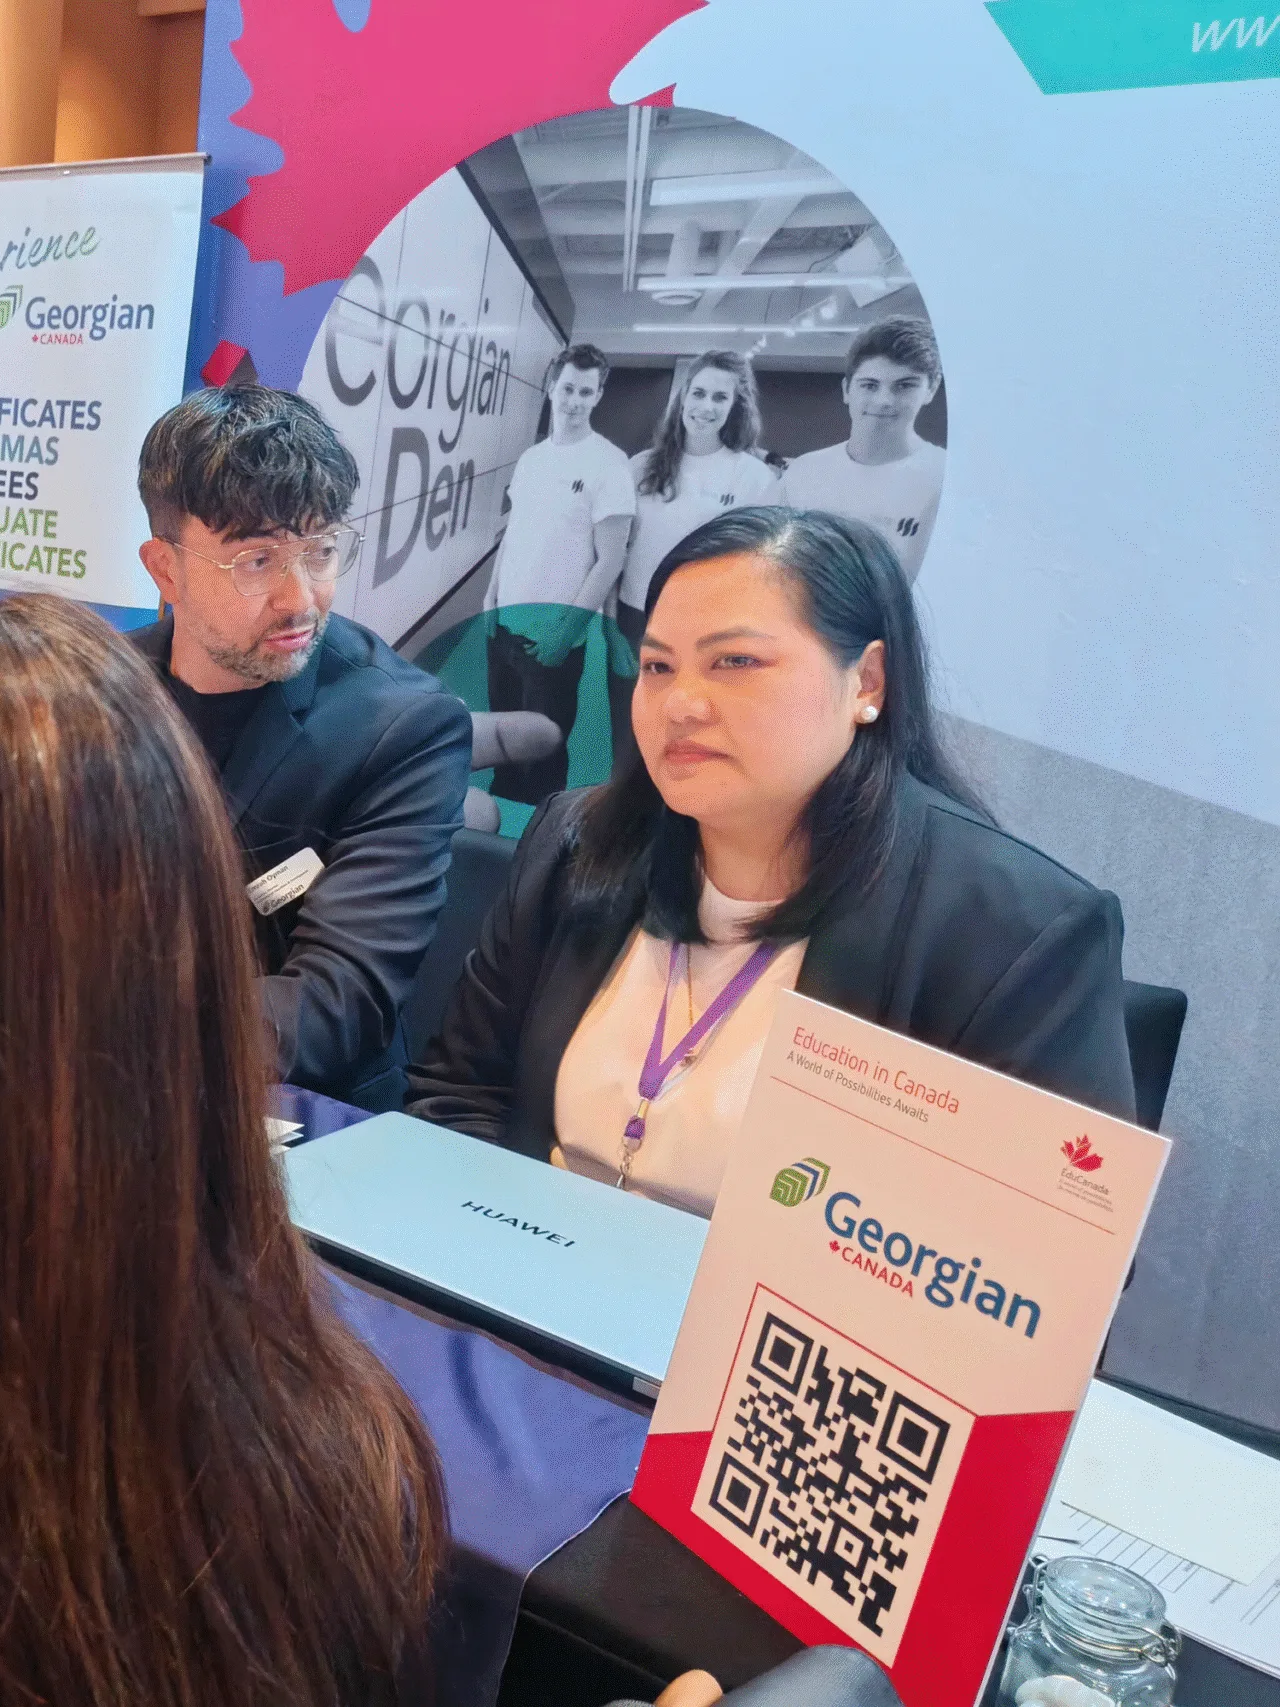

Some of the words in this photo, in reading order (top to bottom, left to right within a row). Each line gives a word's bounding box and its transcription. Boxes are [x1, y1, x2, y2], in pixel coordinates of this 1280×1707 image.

[24, 294, 155, 341] Georgian
[39, 332, 84, 345] CANADA
[372, 426, 475, 591] Den
[786, 1050, 794, 1062] A
[796, 1055, 823, 1075] World
[823, 1067, 835, 1080] of
[834, 1072, 893, 1107] Possibilities
[893, 1098, 930, 1123] Awaits
[792, 1025, 870, 1075] Education
[872, 1061, 889, 1084] in
[893, 1070, 960, 1114] Canada
[460, 1200, 576, 1248] HUAWEI
[824, 1191, 1042, 1339] Georgian
[841, 1246, 914, 1299] CANADA
